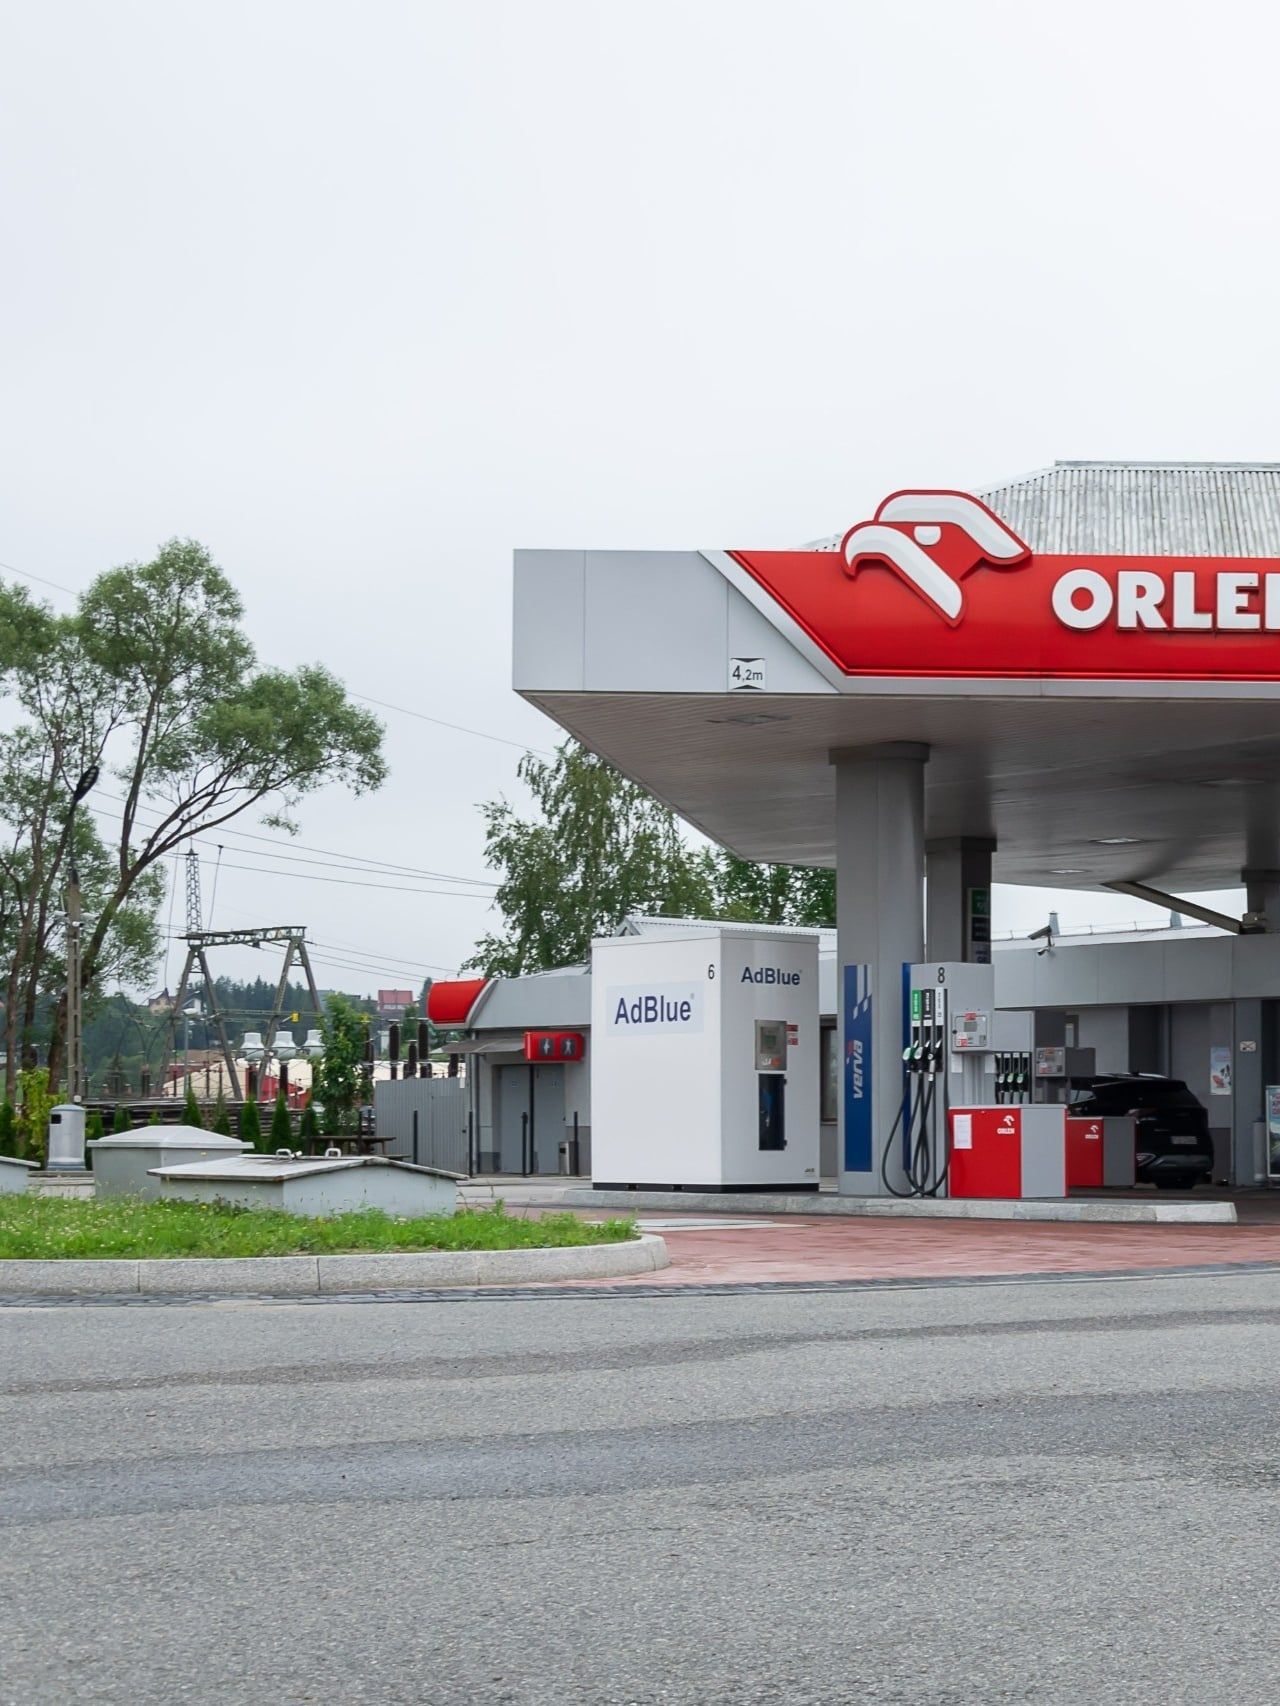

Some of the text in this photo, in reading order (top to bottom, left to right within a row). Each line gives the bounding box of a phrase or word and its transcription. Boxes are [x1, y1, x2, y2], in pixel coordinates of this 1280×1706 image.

[732, 665, 763, 682] 4,2m
[708, 964, 715, 980] 6
[741, 967, 801, 986] AdBlue
[937, 967, 945, 984] 8
[615, 995, 692, 1025] AdBlue
[853, 1039, 863, 1099] verva
